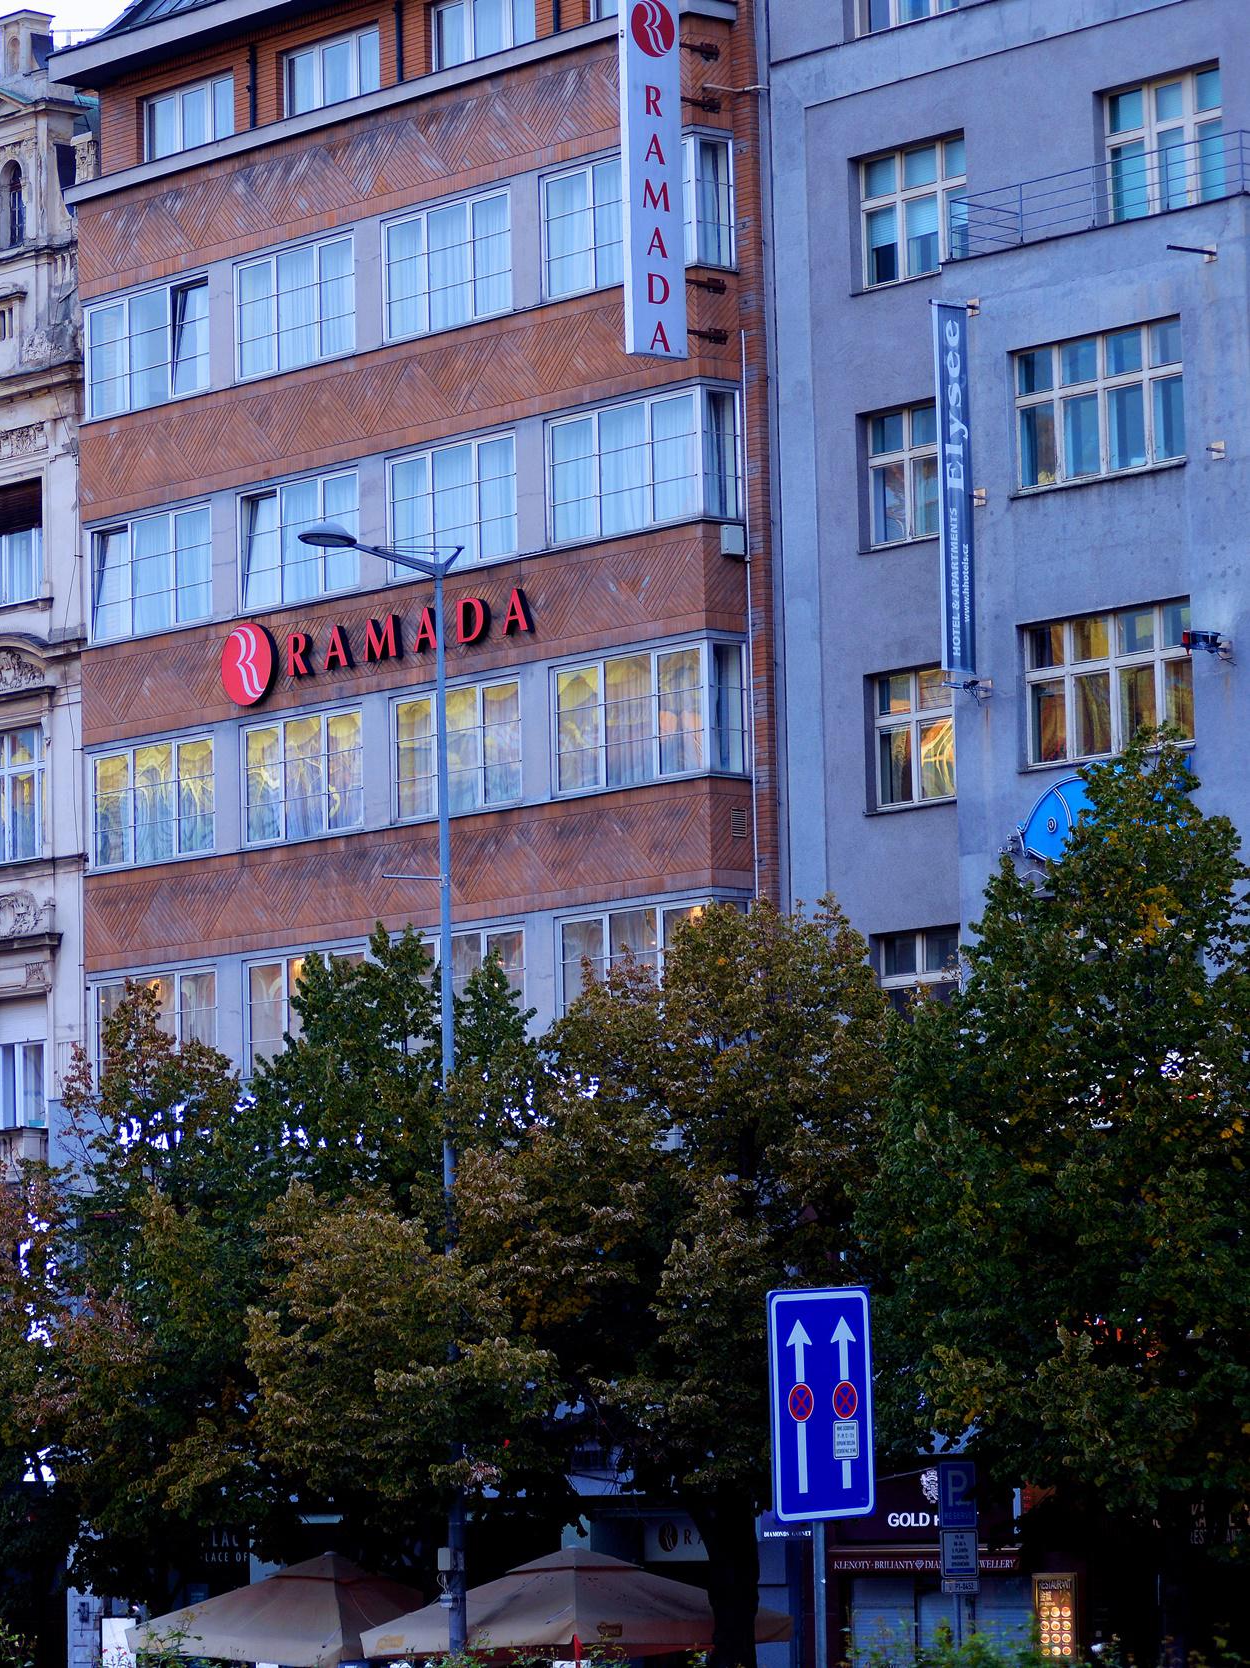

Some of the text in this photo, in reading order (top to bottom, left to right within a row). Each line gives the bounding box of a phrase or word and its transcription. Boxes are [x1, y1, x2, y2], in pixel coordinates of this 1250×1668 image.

[642, 84, 671, 354] RAMADA
[945, 319, 968, 492] Elysee
[949, 507, 961, 657] HOTEL & APARTMENTS
[962, 543, 970, 623] www.hhotels.cz
[287, 587, 534, 677] RAMADA
[763, 1530, 790, 1538] DIAMONDS
[887, 1512, 930, 1527] GOLD
[1038, 1579, 1071, 1590] RESTAURANT
